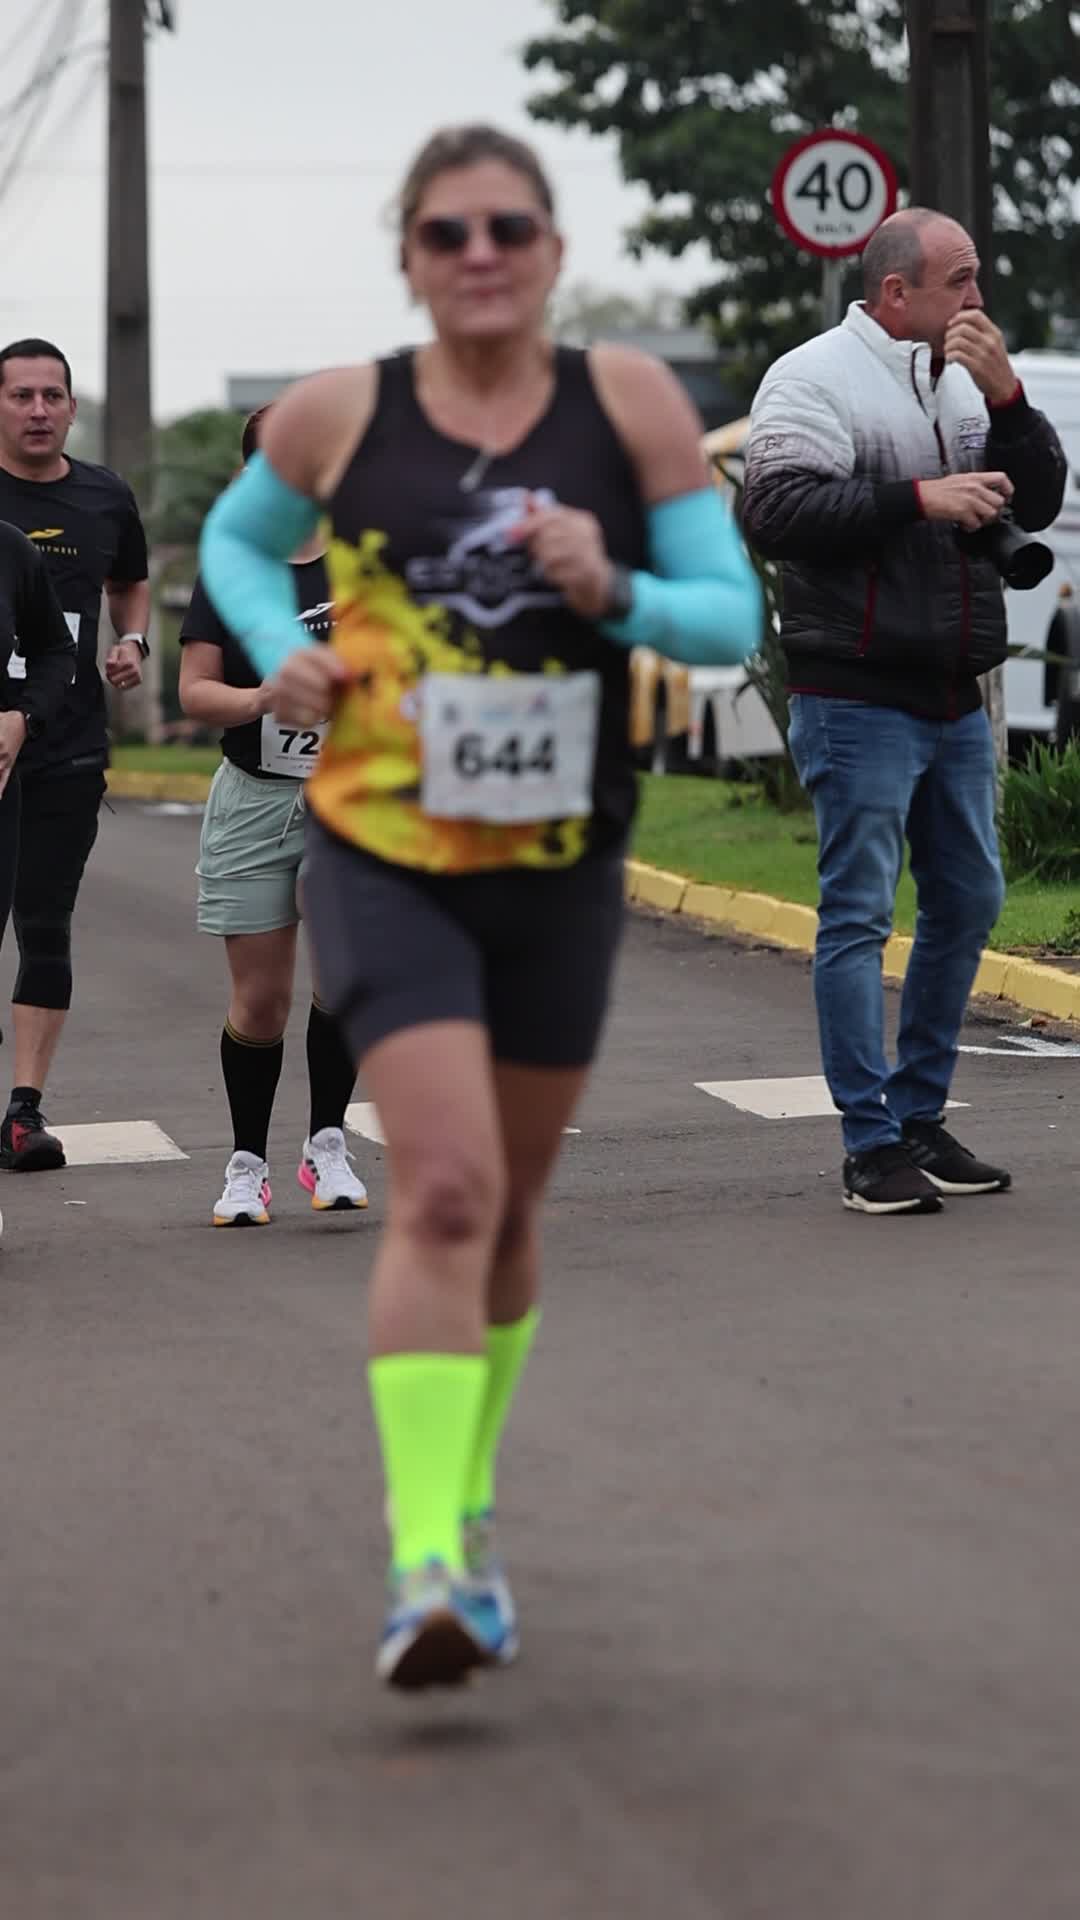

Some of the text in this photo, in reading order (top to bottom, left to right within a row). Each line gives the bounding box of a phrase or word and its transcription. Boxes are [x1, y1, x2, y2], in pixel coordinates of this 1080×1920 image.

[796, 161, 872, 212] 40
[278, 729, 325, 755] 72
[454, 731, 555, 780] 644
